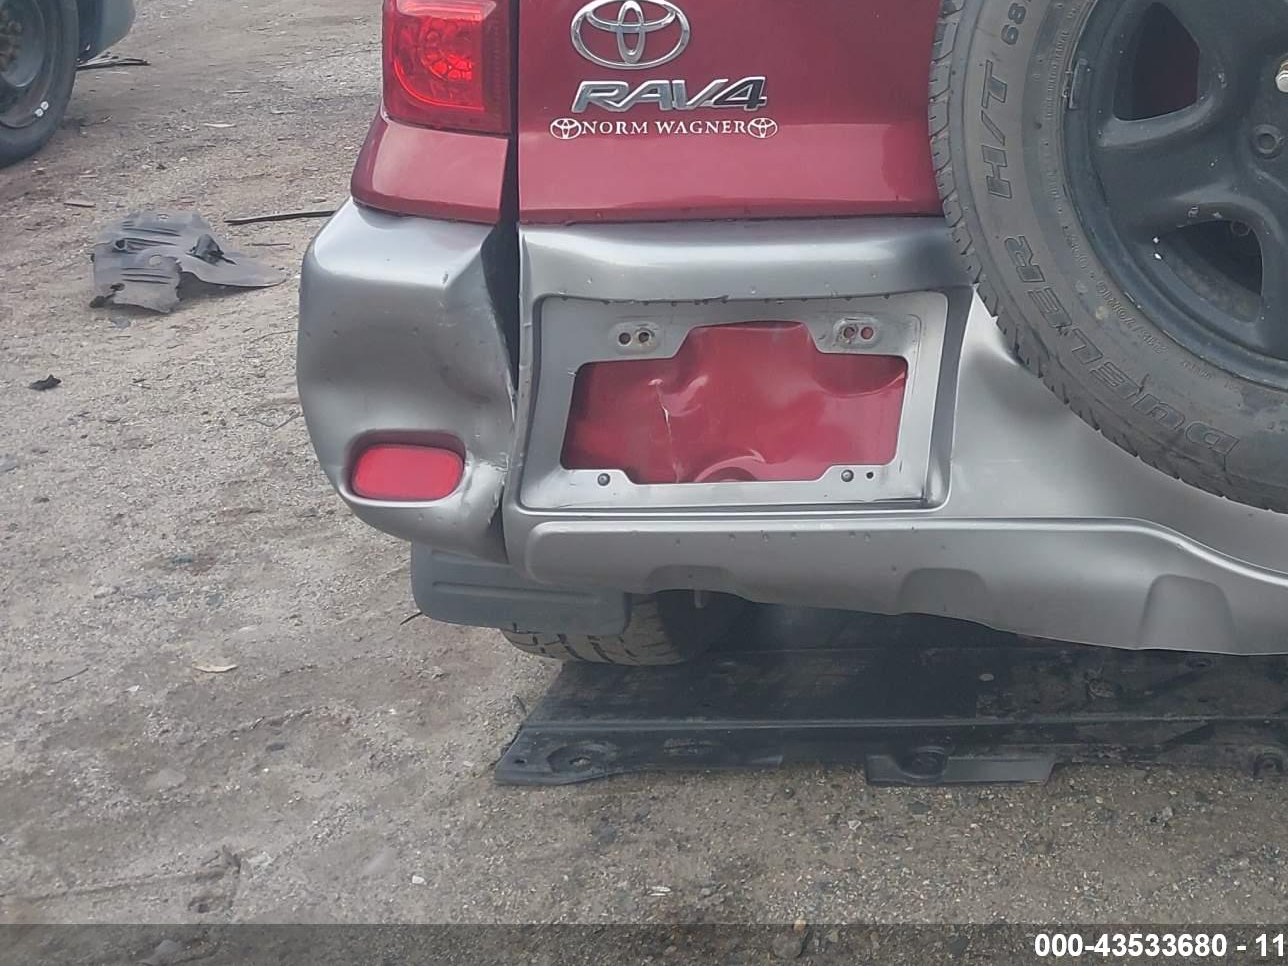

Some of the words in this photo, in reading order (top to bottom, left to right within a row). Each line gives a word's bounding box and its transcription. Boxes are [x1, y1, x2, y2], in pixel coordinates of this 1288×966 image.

[571, 77, 768, 114] RAV4
[582, 120, 648, 135] NORM
[655, 119, 749, 135] WAGNER
[981, 59, 1013, 200] H/T
[1004, 235, 1240, 455] DUELER
